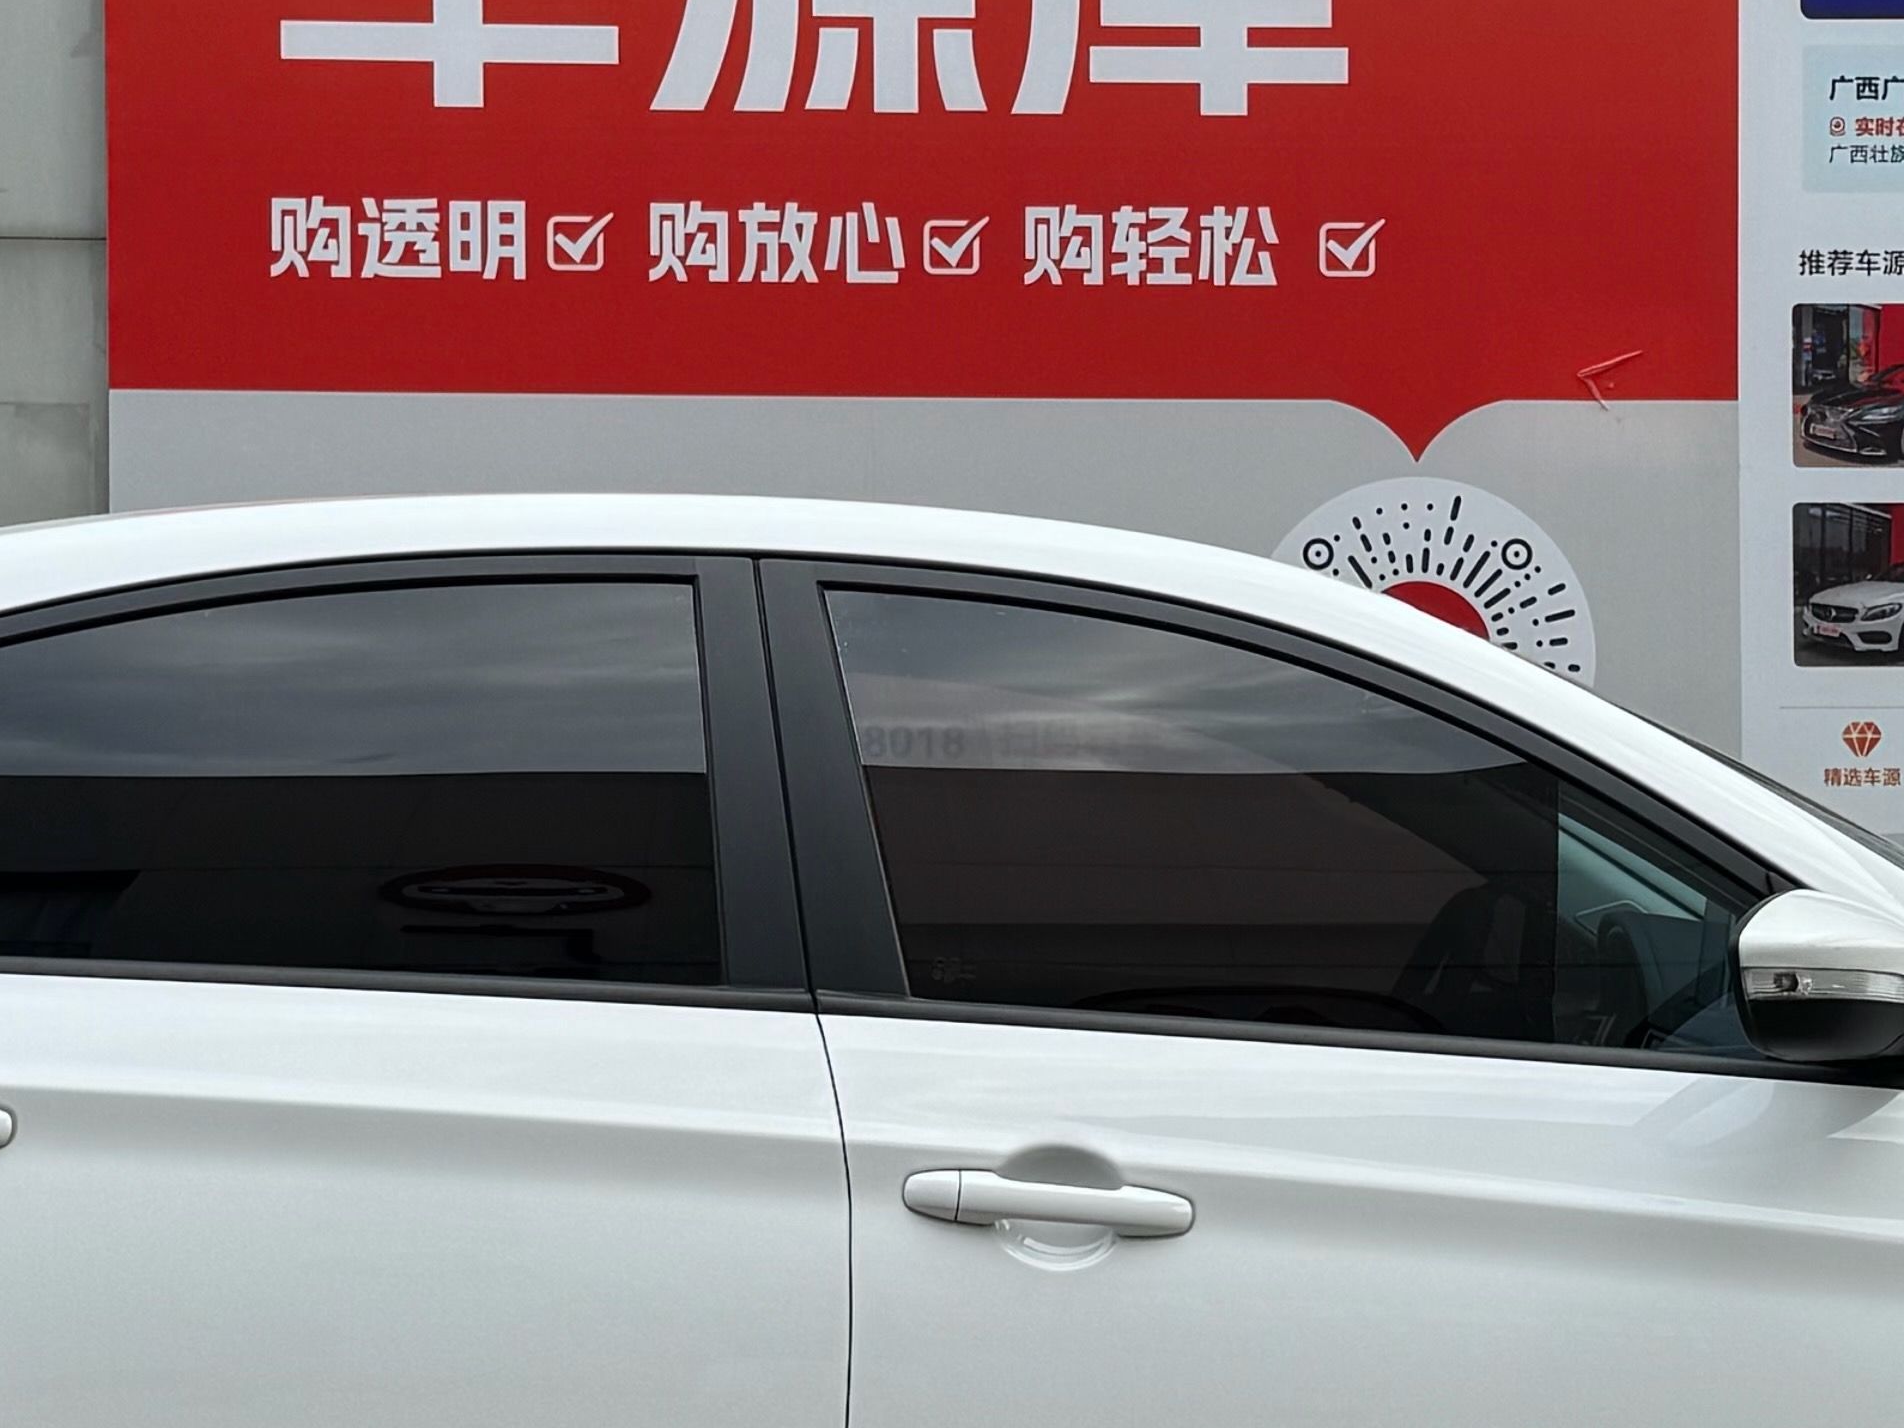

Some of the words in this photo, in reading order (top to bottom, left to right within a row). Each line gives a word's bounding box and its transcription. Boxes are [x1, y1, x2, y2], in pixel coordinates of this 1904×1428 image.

[270, 196, 526, 280] 购透明
[649, 201, 905, 283] 购放心
[1024, 204, 1279, 286] 购轻松
[1824, 768, 1901, 786] 精选车源
